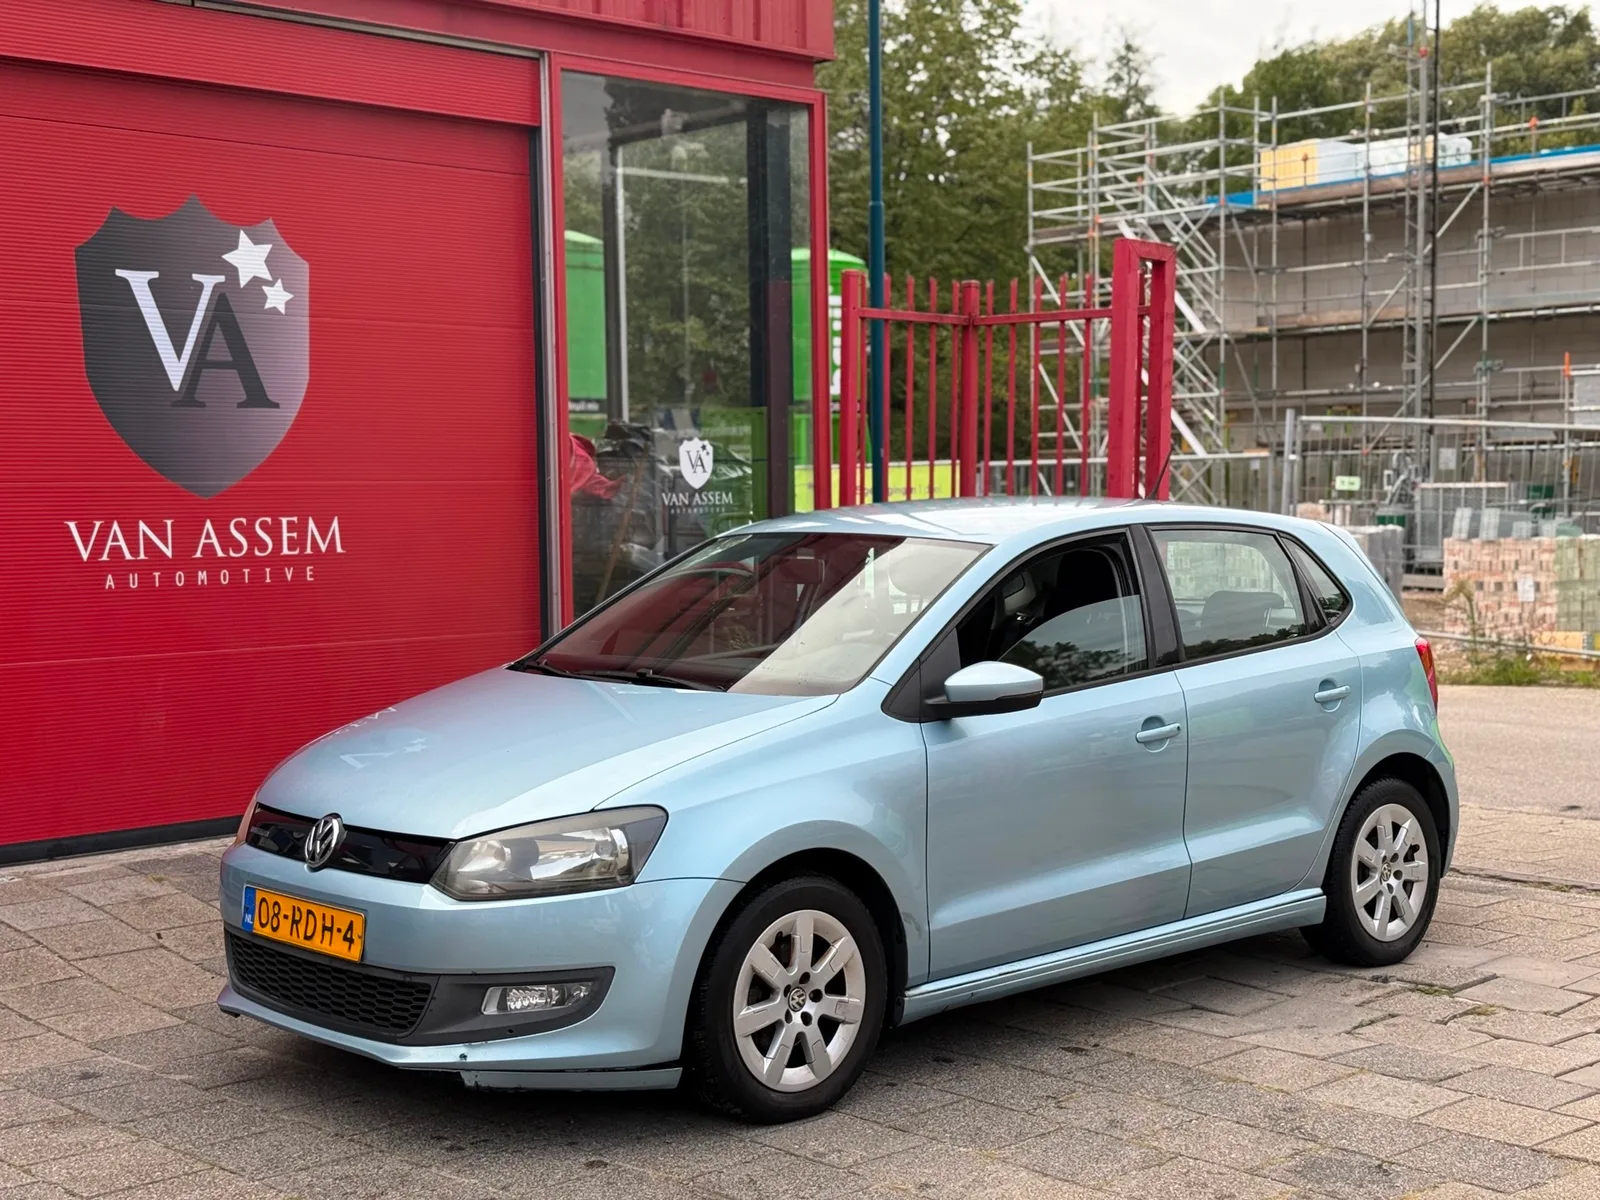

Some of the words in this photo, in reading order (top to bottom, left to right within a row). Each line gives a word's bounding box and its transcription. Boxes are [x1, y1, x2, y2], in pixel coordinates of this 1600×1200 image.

[661, 492, 689, 506] VAN
[693, 491, 733, 505] ASSEM
[64, 519, 174, 562] VAN
[192, 515, 346, 558] ASSEM
[105, 565, 315, 590] AUTOMOTIVE
[244, 912, 253, 924] NL
[258, 896, 355, 952] 08-RDH-4
